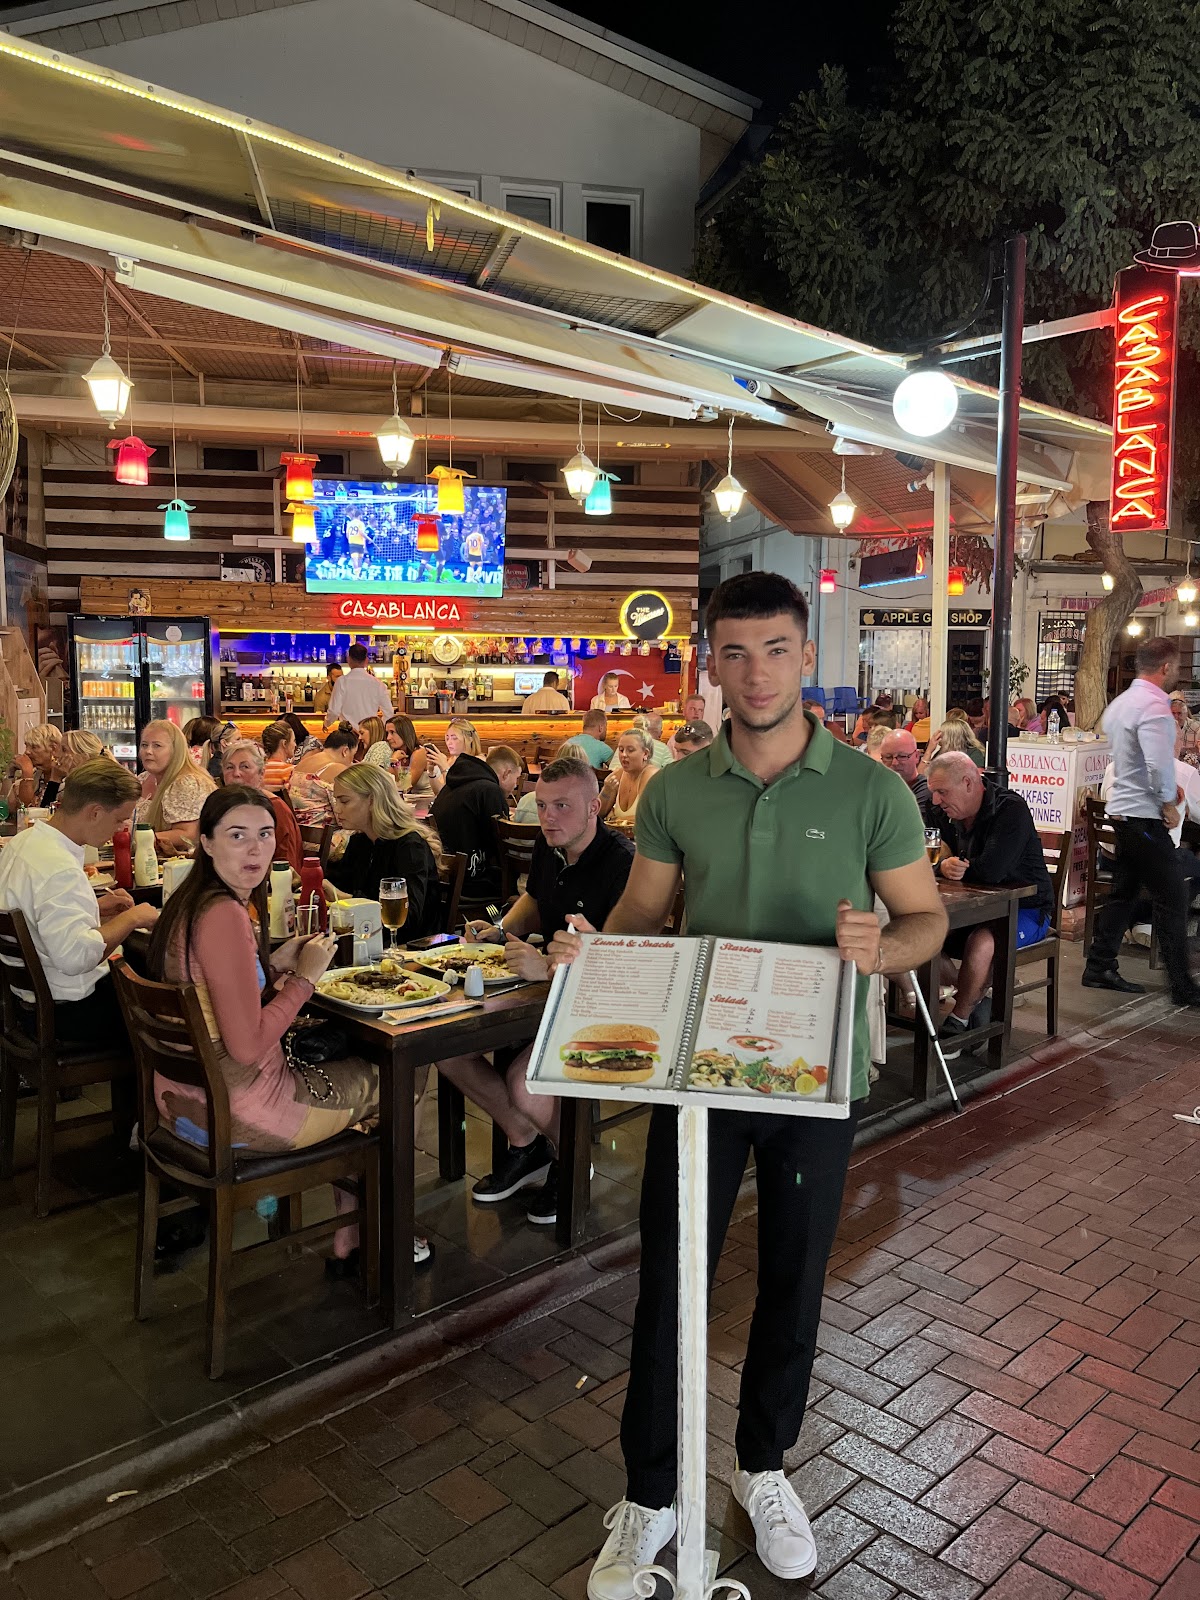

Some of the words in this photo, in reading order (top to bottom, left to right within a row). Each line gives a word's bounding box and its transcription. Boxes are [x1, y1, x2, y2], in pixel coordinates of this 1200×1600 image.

[1111, 295, 1165, 523] CASABLANCA
[340, 599, 461, 621] CASABLANCA
[881, 612, 920, 623] APPLE
[951, 612, 983, 624] SHOP
[1006, 753, 1068, 772] SABLANCA
[1022, 774, 1065, 787] MARCO
[363, 924, 370, 933] 5
[590, 936, 625, 947] Lunch
[626, 939, 637, 948] &
[638, 939, 675, 948] Snacks
[720, 942, 763, 954] Starters
[709, 993, 749, 1006] Salads
